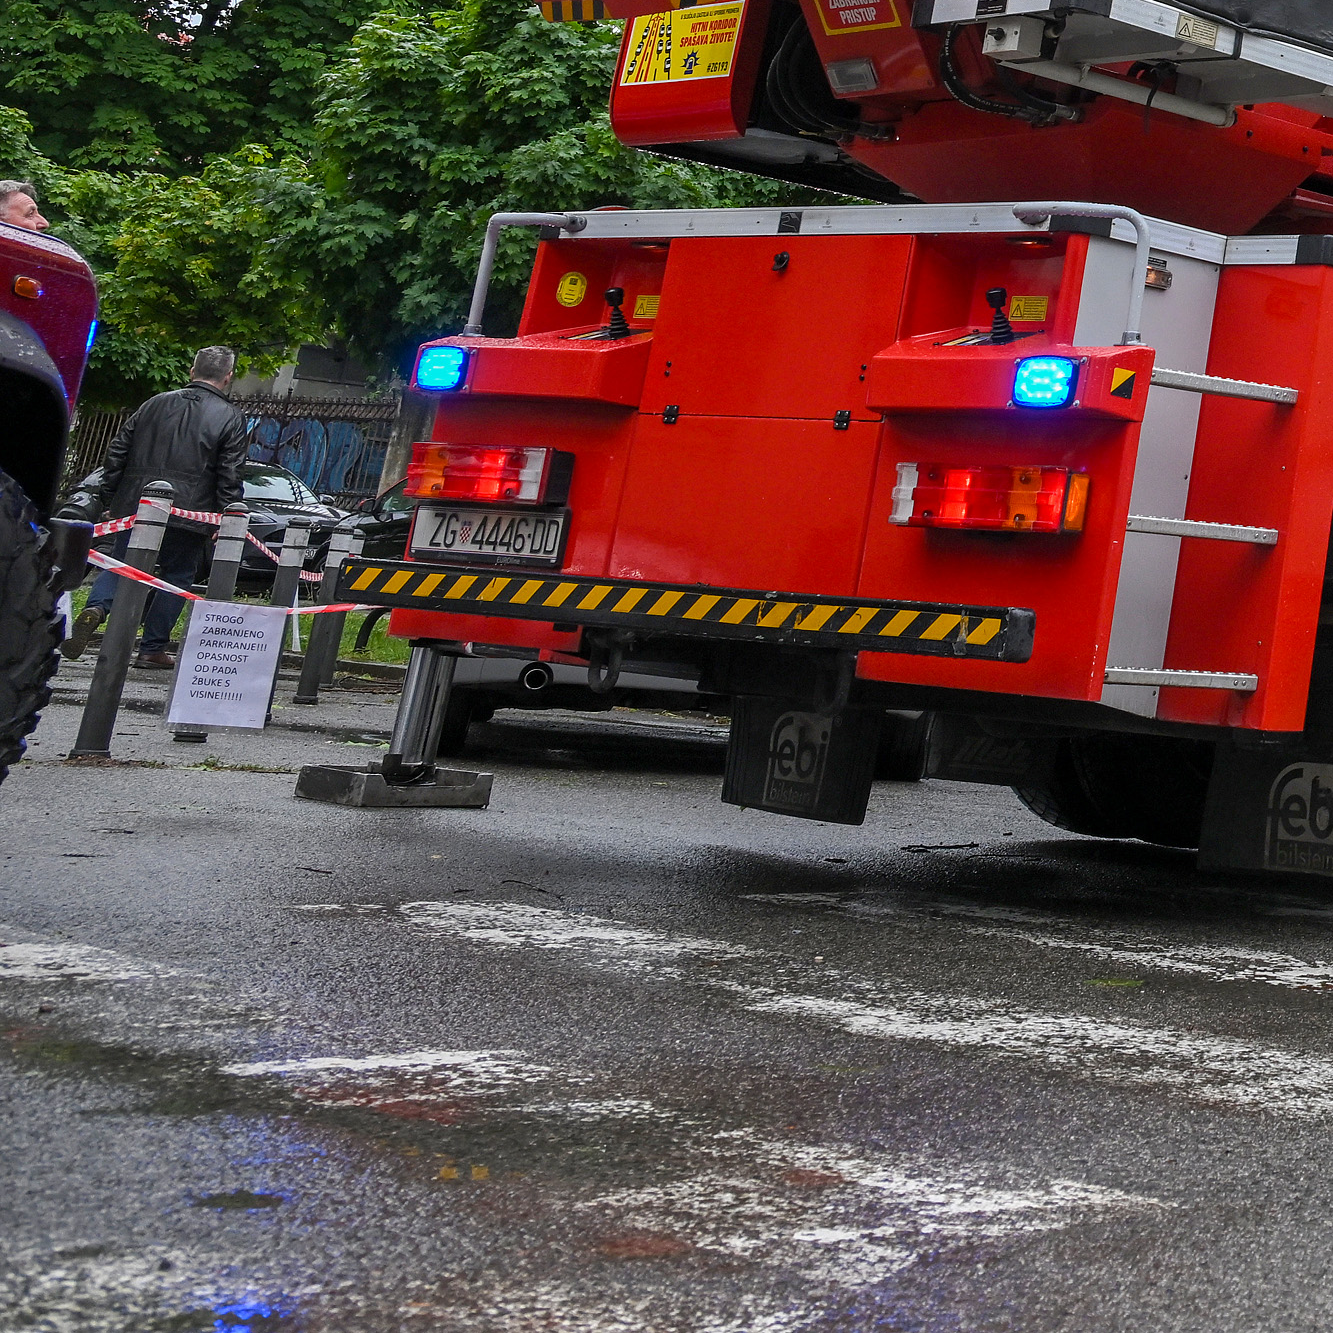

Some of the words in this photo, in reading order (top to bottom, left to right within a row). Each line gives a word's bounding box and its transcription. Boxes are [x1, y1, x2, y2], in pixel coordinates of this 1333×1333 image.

[839, 7, 877, 25] PRISTUP
[690, 21, 709, 34] HITNI
[709, 18, 738, 31] KORIDOR
[679, 32, 708, 48] SPAŠAVA
[709, 30, 735, 45] ŽIVOTE!
[707, 61, 729, 73] #ZG193
[429, 512, 459, 549] ZG
[204, 613, 244, 625] STROGO
[202, 626, 265, 639] ZABRANJENO
[199, 639, 268, 652] PARKIRANJE!!!
[196, 651, 249, 663] OPASNOST
[194, 664, 210, 673] OD
[211, 666, 238, 675] PADA
[191, 675, 223, 687] ŽBUKE
[224, 679, 231, 688] S
[189, 690, 243, 702] VISINE!!!!!!
